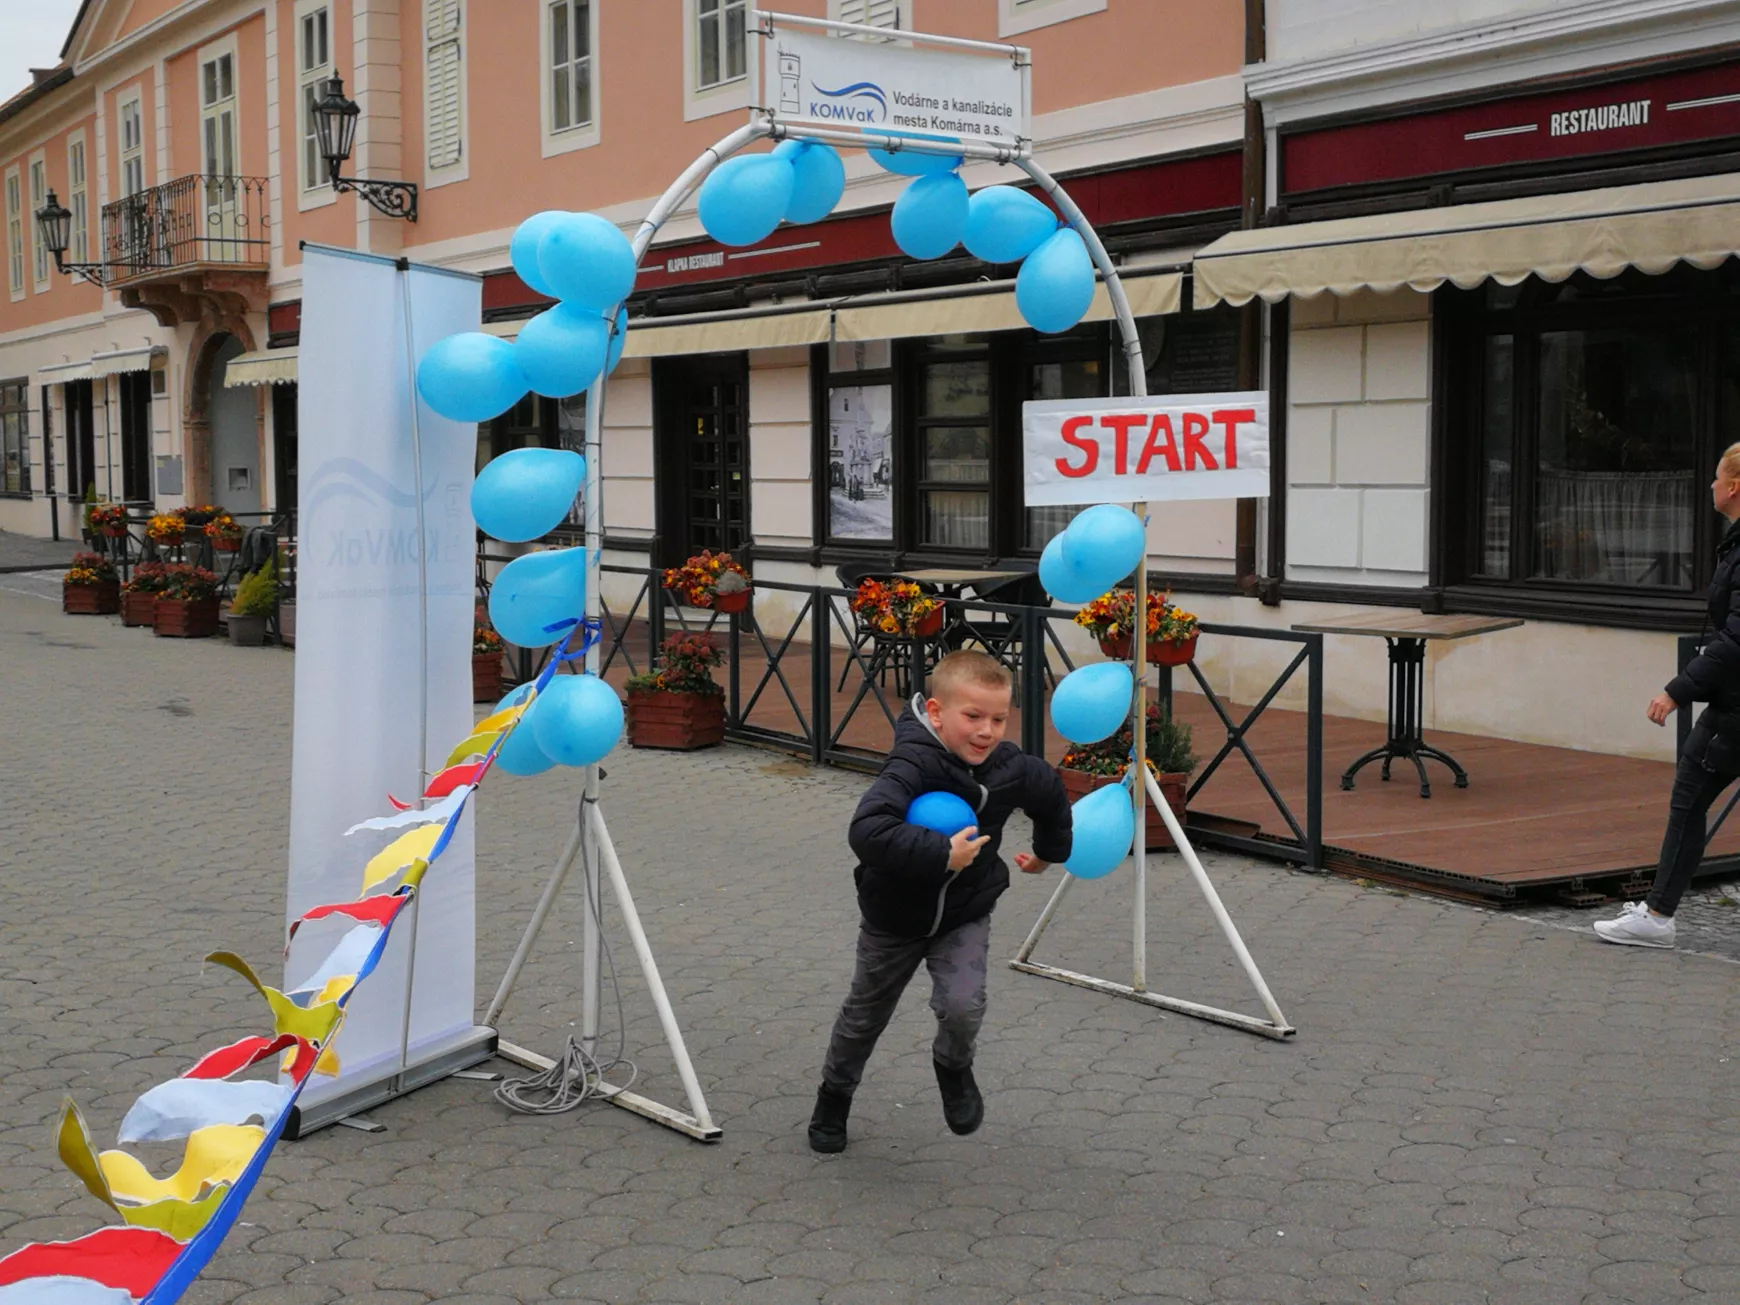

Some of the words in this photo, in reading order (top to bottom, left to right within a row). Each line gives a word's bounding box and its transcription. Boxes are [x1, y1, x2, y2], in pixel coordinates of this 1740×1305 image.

[810, 103, 875, 123] KOMVaK
[893, 91, 939, 110] Vodárne
[942, 101, 949, 111] a
[952, 96, 1013, 118] kanalizácie
[893, 114, 928, 129] mesta
[931, 117, 981, 135] Komárna
[983, 123, 1003, 137] a.s.
[1550, 100, 1651, 137] RESTAURANT
[1055, 409, 1256, 479] START
